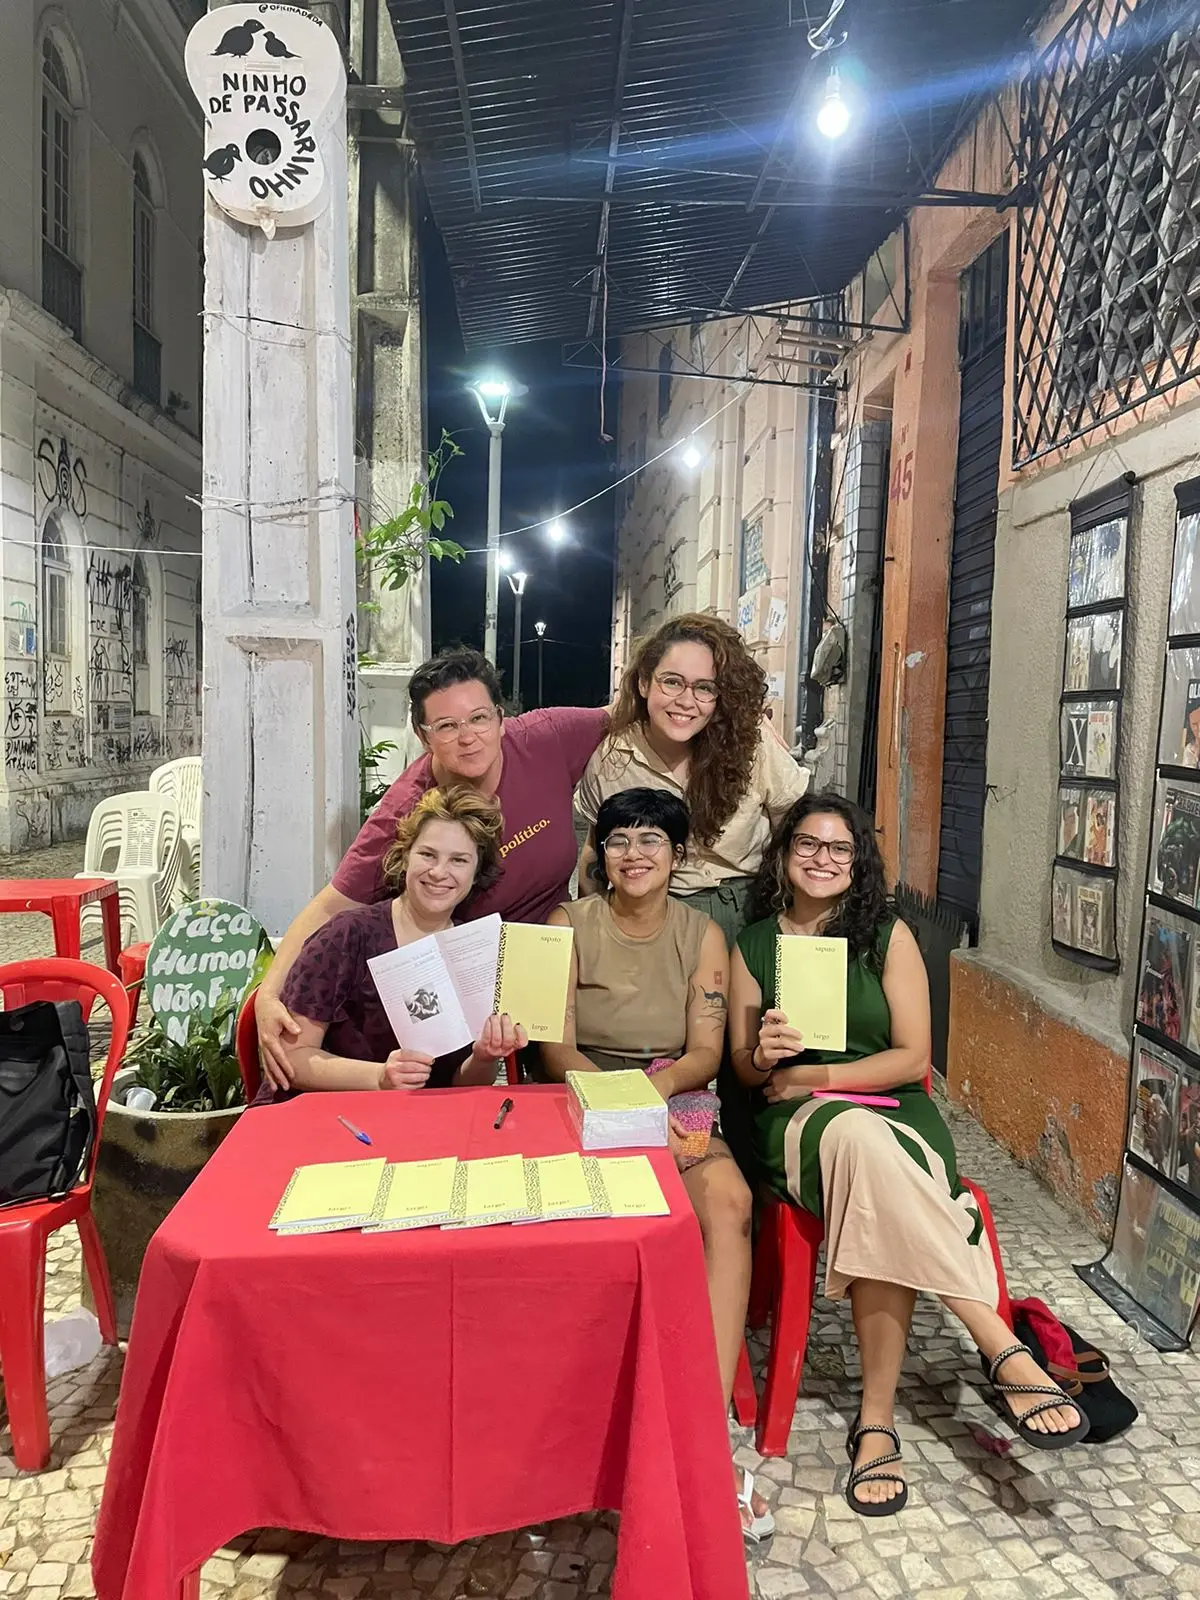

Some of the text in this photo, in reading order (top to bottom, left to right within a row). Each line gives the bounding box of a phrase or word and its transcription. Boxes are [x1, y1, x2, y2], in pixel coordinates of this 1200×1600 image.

[223, 73, 306, 97] NINHO
[209, 94, 317, 199] DE PASSARINHO
[890, 450, 914, 506] 45
[1065, 717, 1088, 766] X
[499, 819, 551, 858] político.
[168, 907, 253, 943] Faça
[152, 983, 207, 1012] Não
